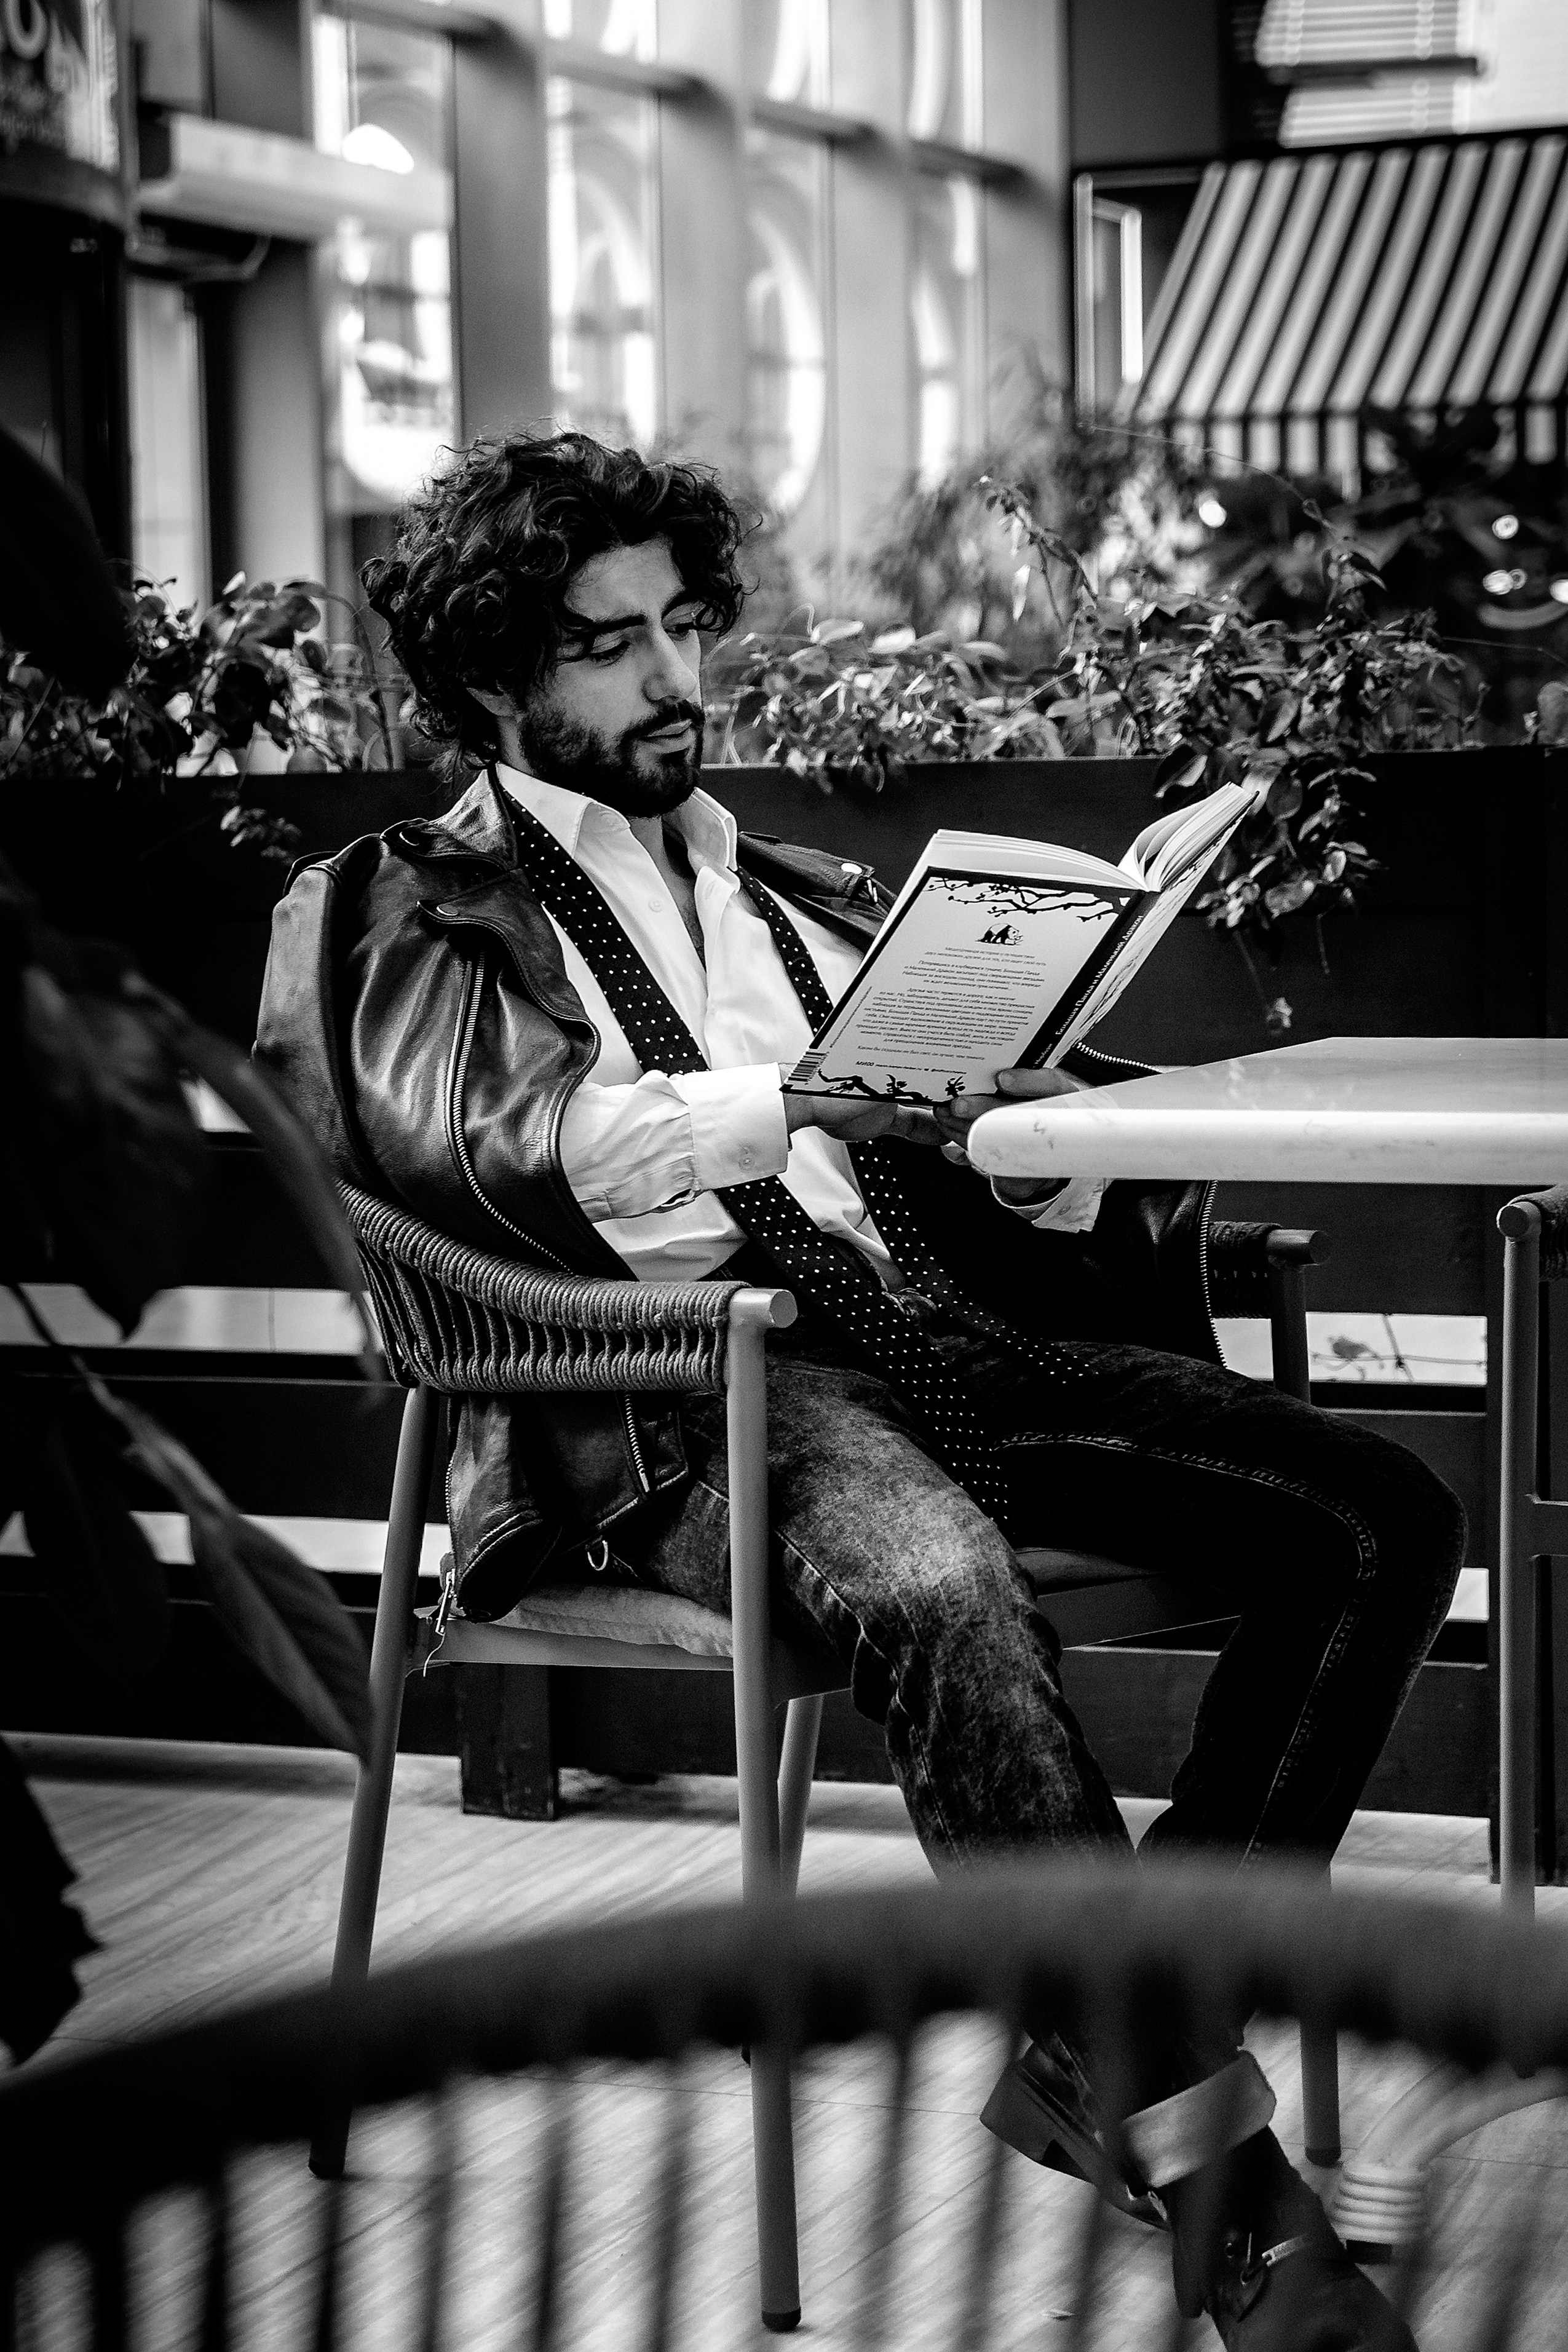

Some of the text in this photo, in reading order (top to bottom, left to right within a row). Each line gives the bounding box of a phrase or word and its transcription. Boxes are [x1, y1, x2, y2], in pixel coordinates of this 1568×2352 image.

[1055, 1007, 1079, 1035] Большая
[1075, 984, 1095, 1007] Панда
[1095, 941, 1125, 978] Маленький
[1122, 915, 1144, 941] Дракон
